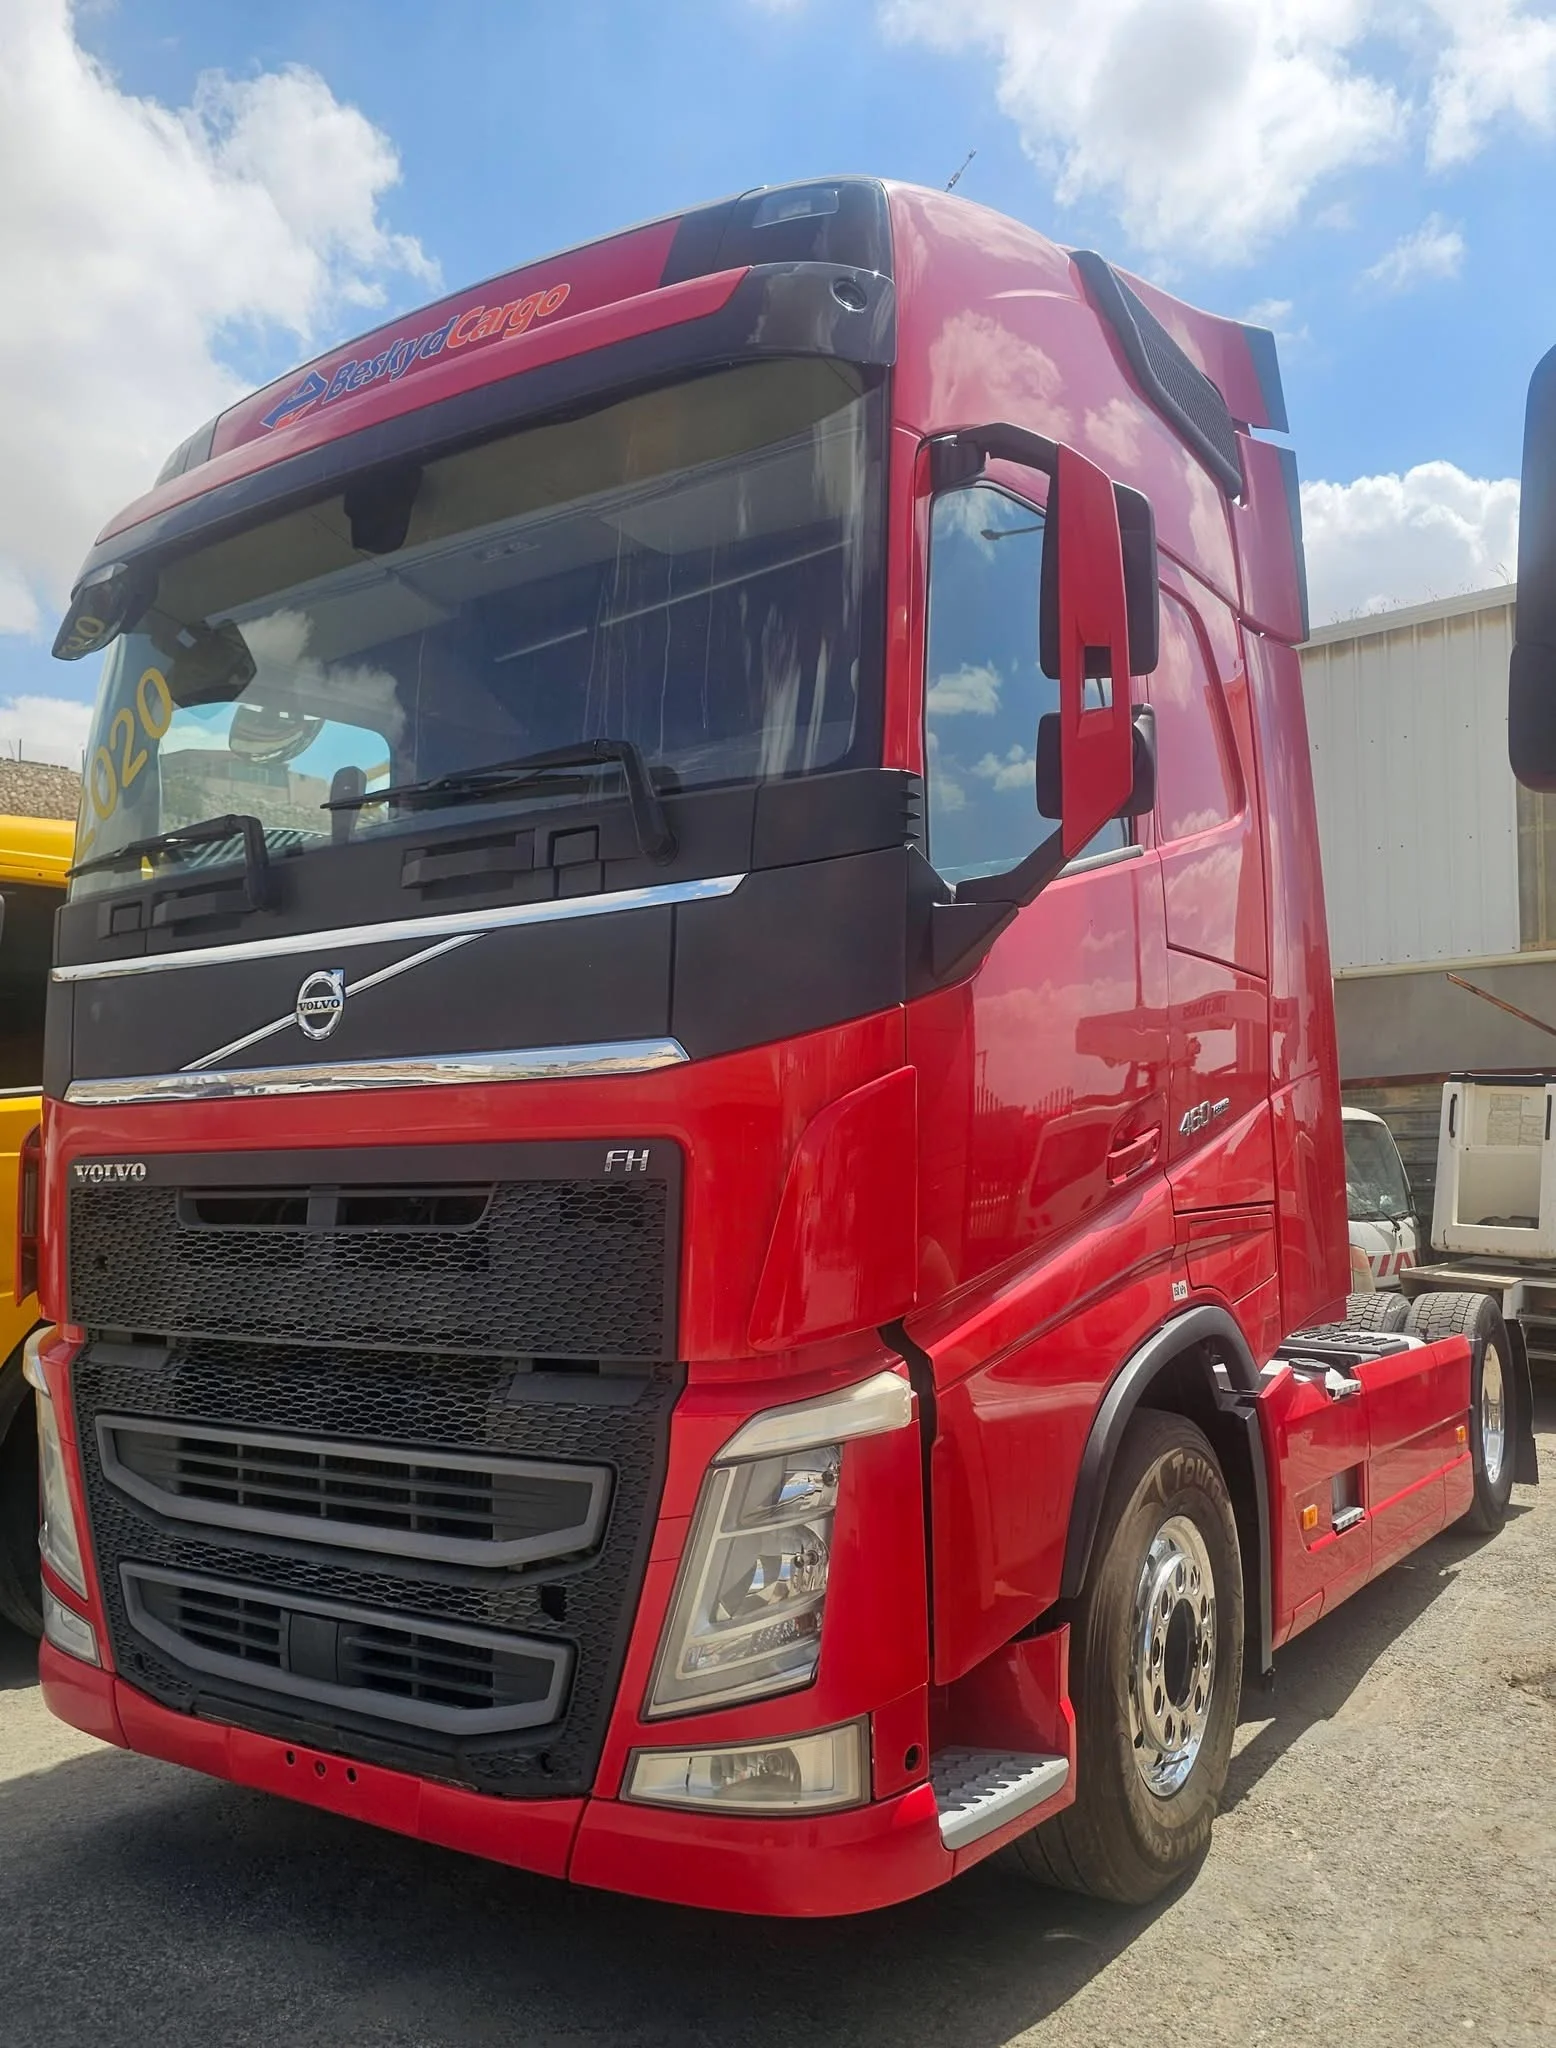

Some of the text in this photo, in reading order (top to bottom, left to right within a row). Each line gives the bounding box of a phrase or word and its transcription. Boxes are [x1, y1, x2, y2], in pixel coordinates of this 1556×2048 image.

[298, 999, 340, 1011] VOLVO
[1179, 1100, 1210, 1136] 460
[604, 1149, 650, 1172] FH
[74, 1163, 147, 1183] VOLVO
